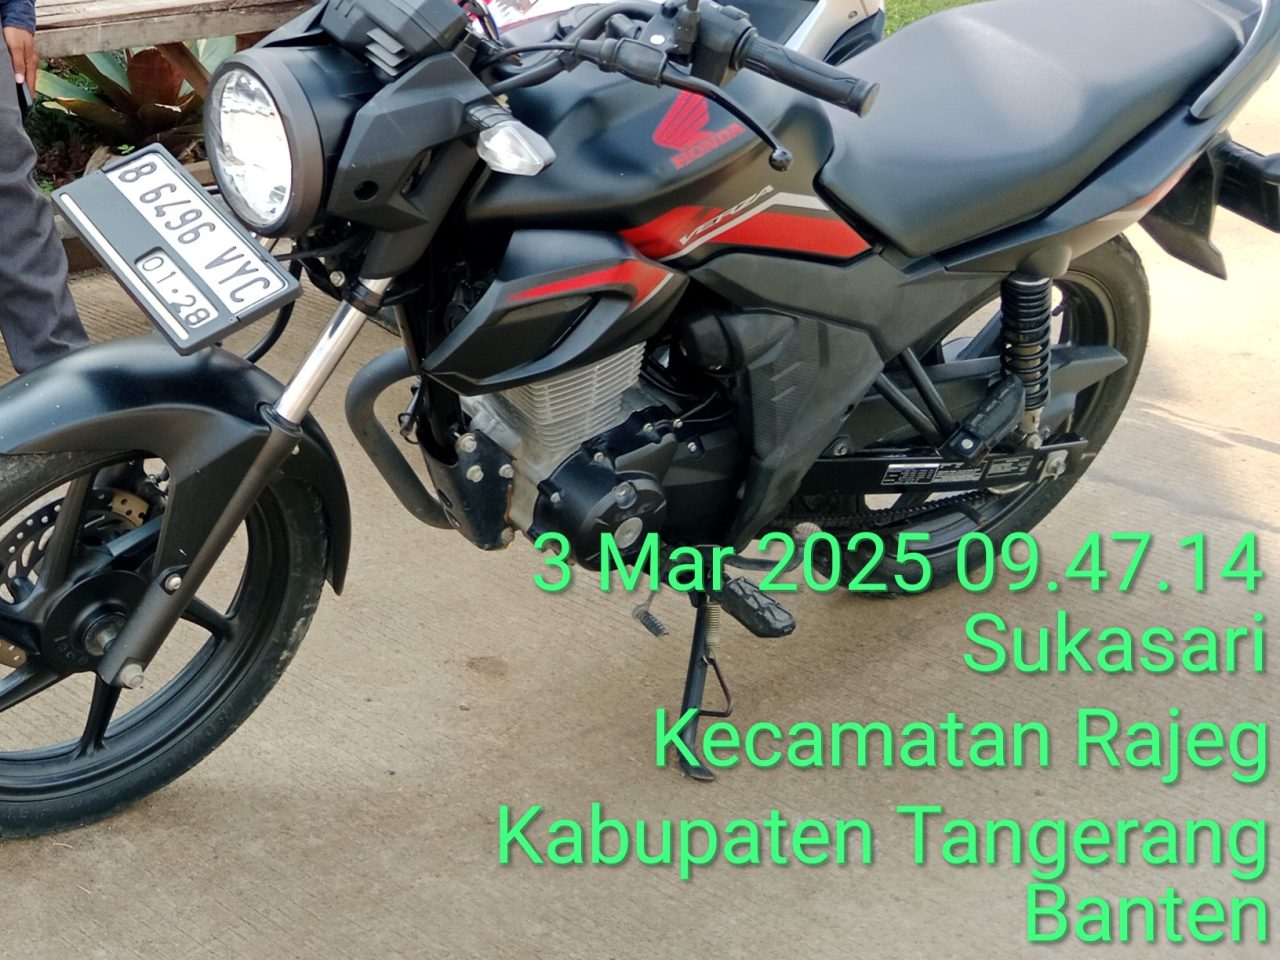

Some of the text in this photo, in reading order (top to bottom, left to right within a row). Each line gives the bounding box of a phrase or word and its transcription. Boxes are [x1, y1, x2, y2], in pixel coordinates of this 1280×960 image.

[670, 122, 747, 171] HONDA
[118, 161, 271, 303] B 6496 VYC
